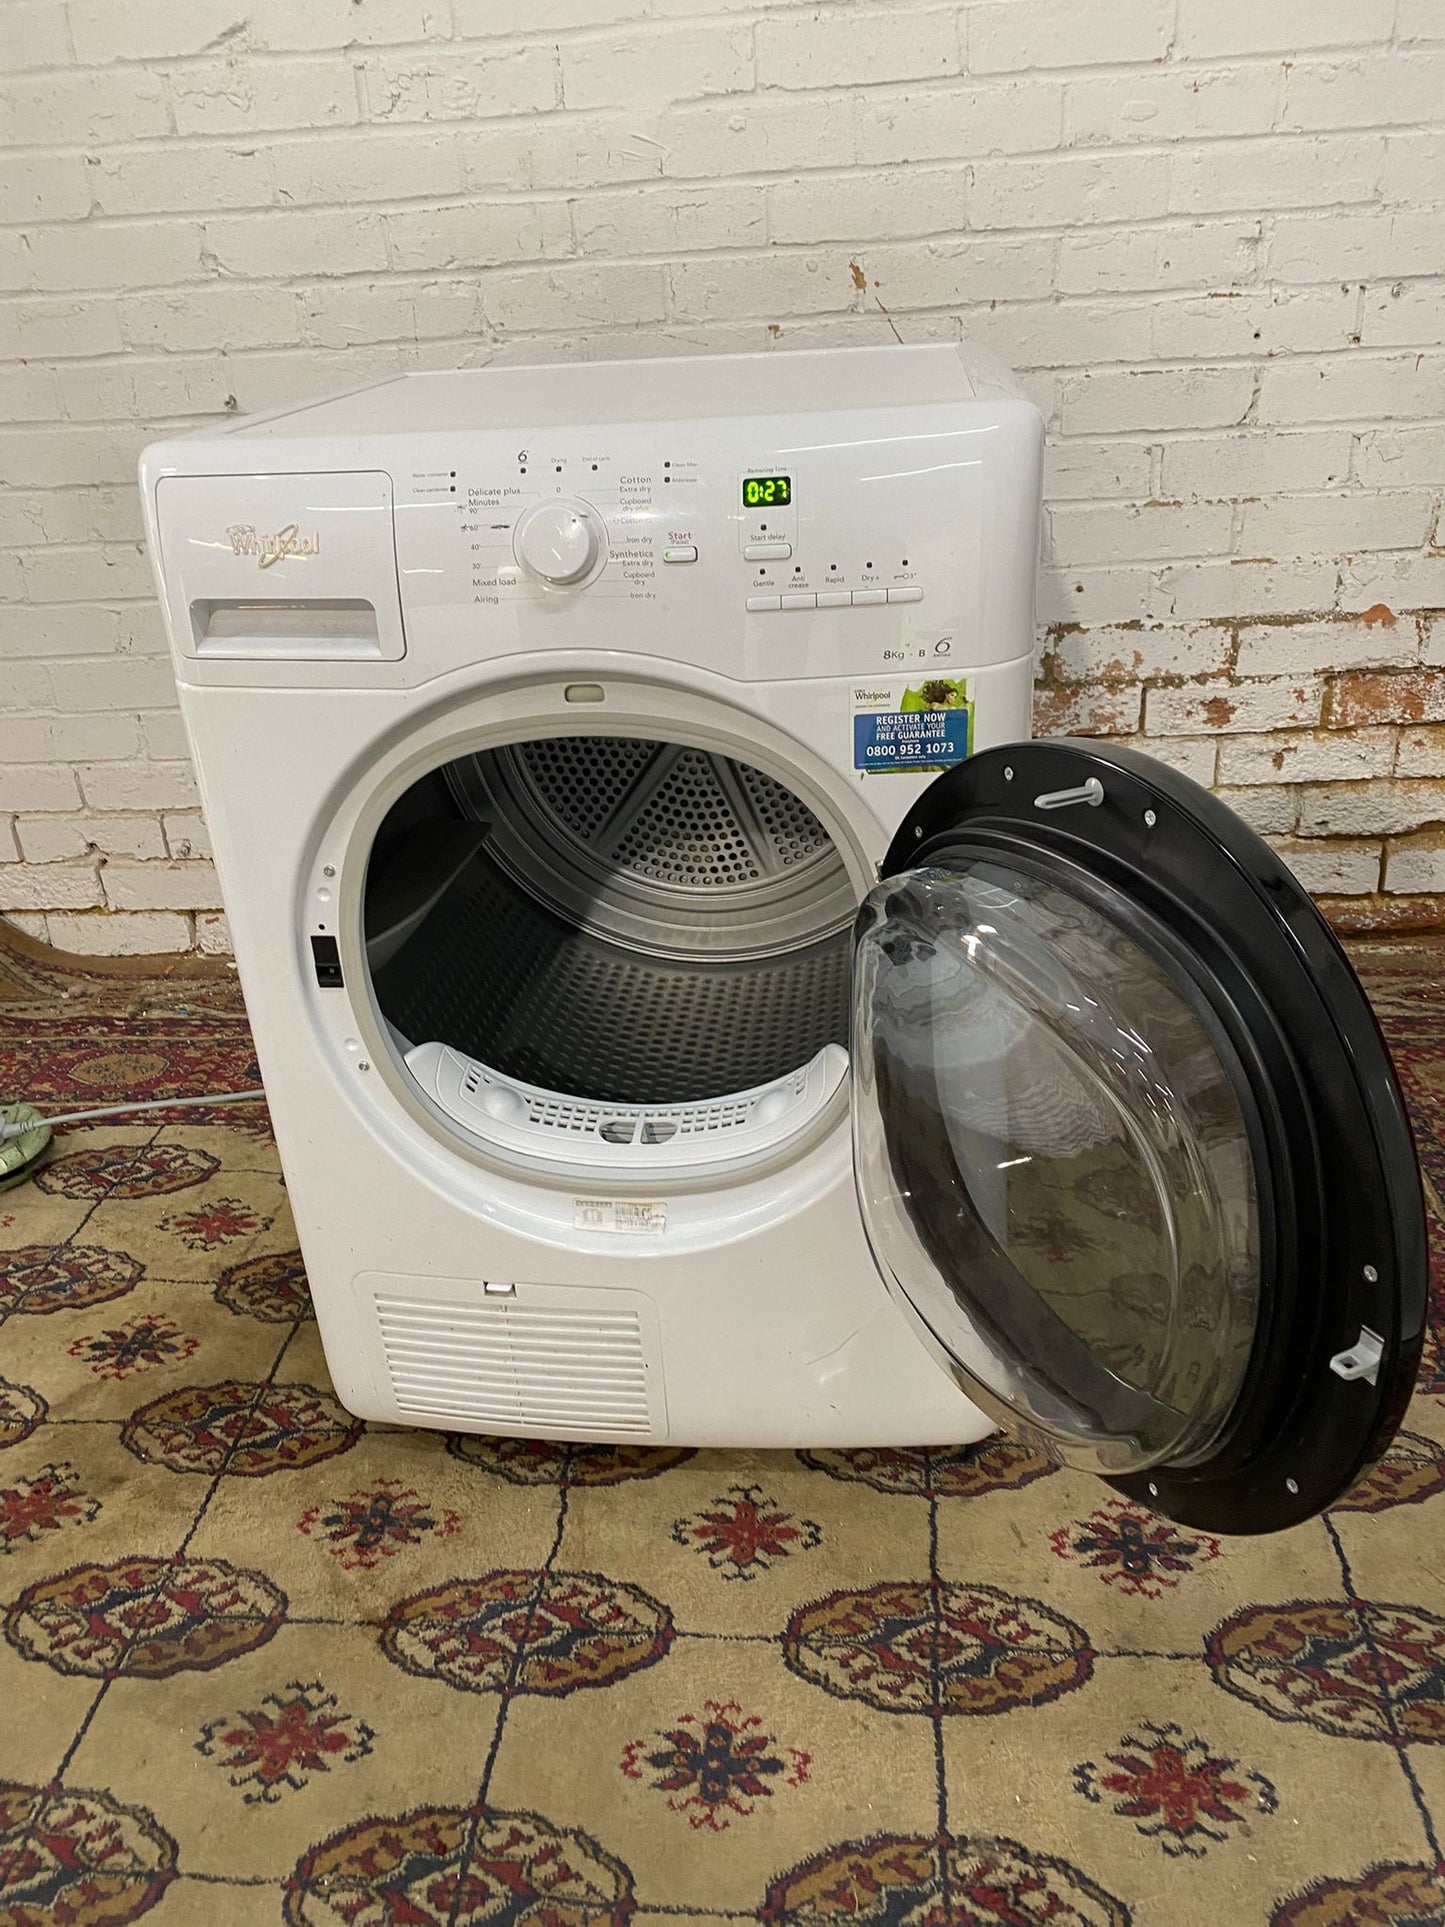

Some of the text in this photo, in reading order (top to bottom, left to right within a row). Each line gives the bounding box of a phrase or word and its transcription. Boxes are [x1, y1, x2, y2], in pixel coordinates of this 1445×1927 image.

[620, 476, 651, 484] Cotton
[468, 487, 520, 497] Delicate plus
[639, 485, 651, 494] dry
[747, 480, 787, 503] 0:27
[620, 497, 652, 506] Cupboard
[641, 536, 653, 544] dry
[668, 531, 692, 540] Start
[750, 532, 786, 542] Start delay
[227, 526, 320, 563] Whirlpool
[609, 550, 653, 559] Synthetics
[472, 577, 517, 587] Mixed load
[753, 580, 775, 588] Gentle
[825, 576, 845, 584] Rapid
[474, 595, 499, 604] Airing
[645, 592, 656, 600] dry
[883, 649, 926, 661] 8Kg B
[854, 690, 891, 701] Whirlpool
[876, 712, 946, 725] REGISTER NOW
[893, 723, 925, 732] ACTIVATE
[926, 722, 946, 730] YOUR
[876, 730, 946, 741] FREE GUARANTEE
[866, 741, 955, 757] 0800 952 1073
